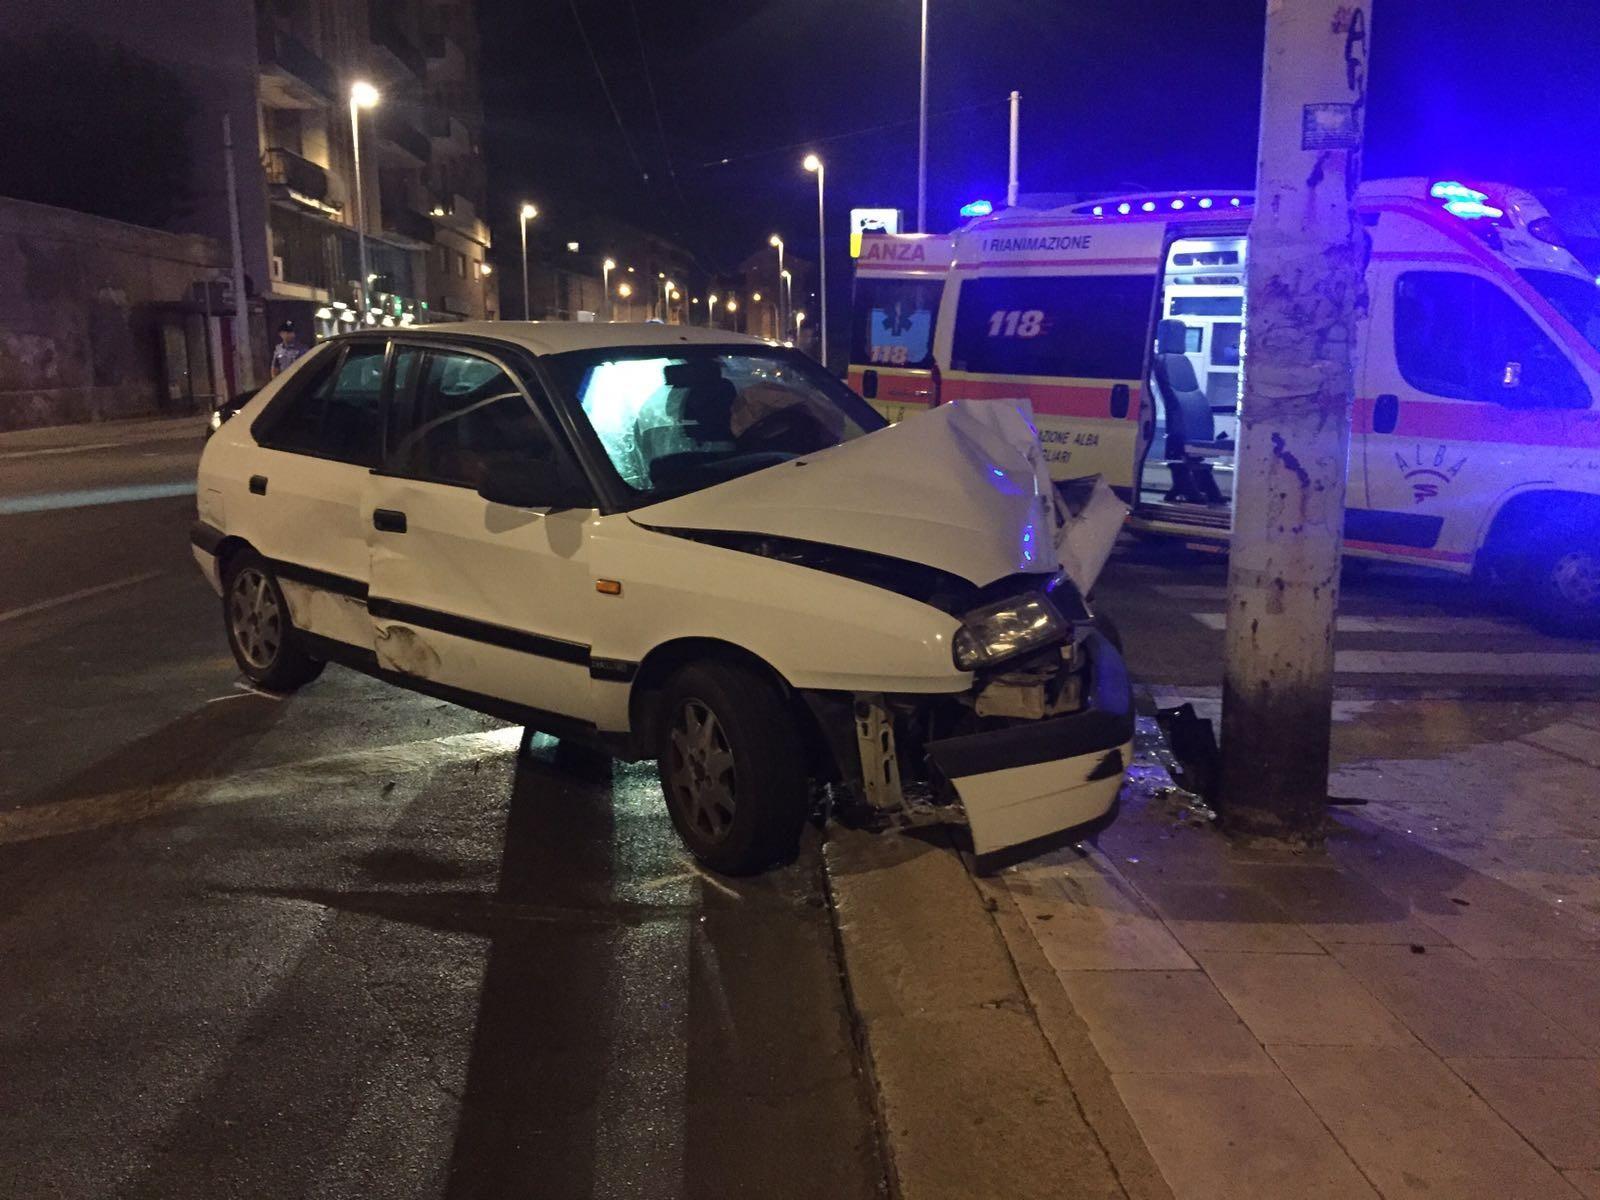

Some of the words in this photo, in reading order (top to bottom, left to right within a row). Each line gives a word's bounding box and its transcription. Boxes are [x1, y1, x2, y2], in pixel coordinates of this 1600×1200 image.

[861, 242, 926, 261] ANZA
[990, 235, 1092, 252] RIANIMAZIONE
[988, 310, 1045, 337] 118
[870, 345, 908, 363] 118
[1073, 433, 1099, 447] ALBA
[1395, 443, 1468, 477] ALBA
